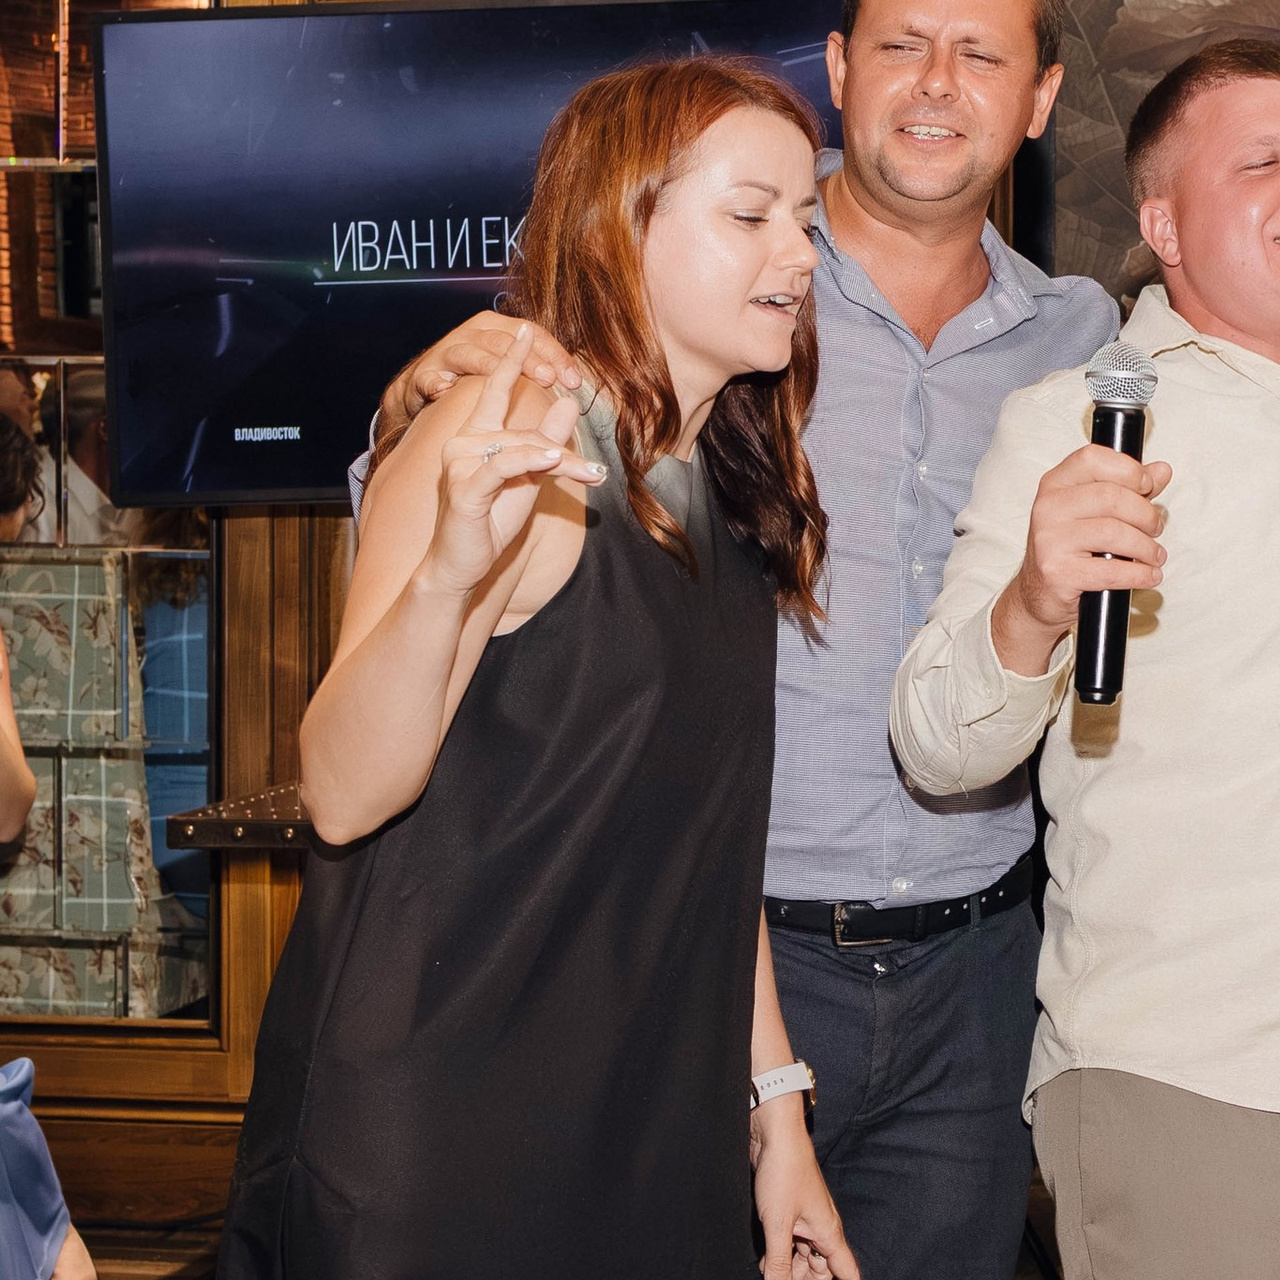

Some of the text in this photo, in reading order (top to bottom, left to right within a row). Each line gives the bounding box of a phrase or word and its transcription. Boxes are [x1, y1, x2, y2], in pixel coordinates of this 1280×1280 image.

[332, 219, 436, 272] ИВАН
[446, 217, 471, 269] И
[234, 426, 301, 441] ВЛАДИВОСТОК
